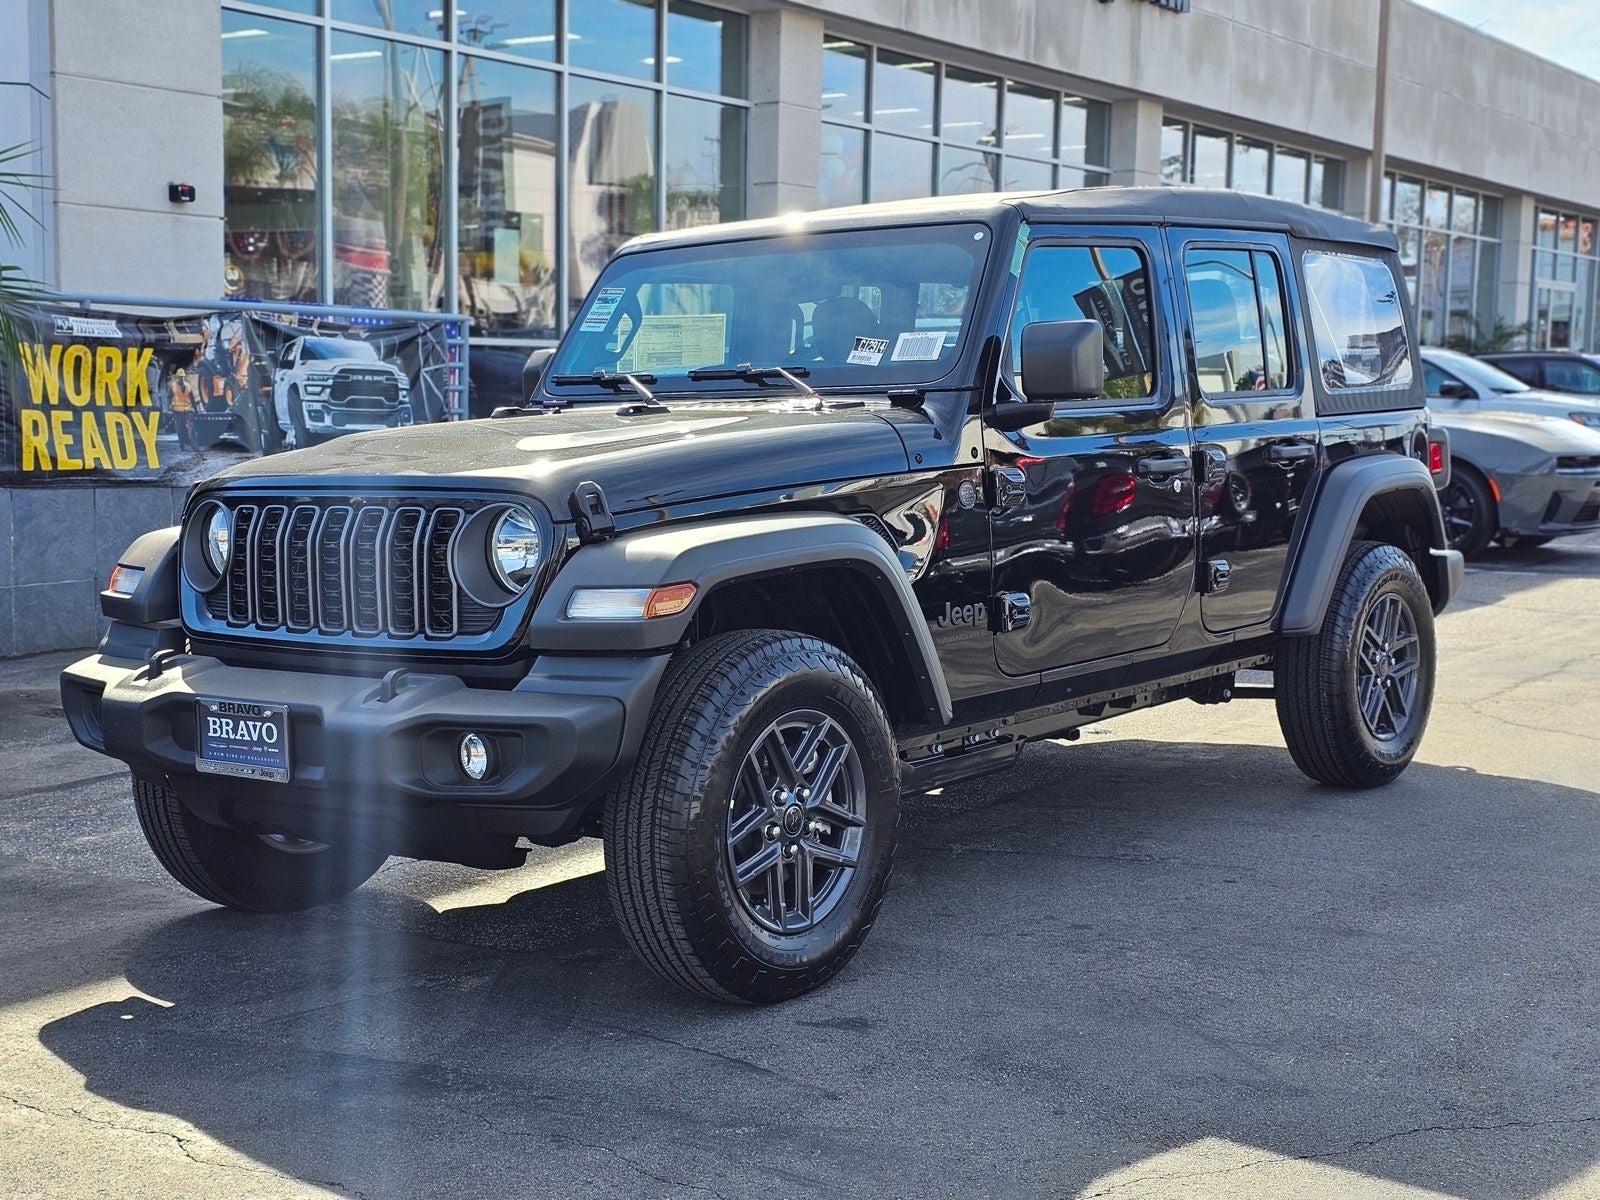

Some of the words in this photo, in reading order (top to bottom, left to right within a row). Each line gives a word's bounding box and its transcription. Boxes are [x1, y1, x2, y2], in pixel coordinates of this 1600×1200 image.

[858, 340, 886, 353] C12914
[18, 341, 154, 407] WORK
[20, 409, 161, 472] READY
[938, 601, 986, 628] Jeep
[218, 702, 262, 716] BRAVO
[207, 717, 278, 743] BRAVO
[258, 770, 274, 779] Jeep
